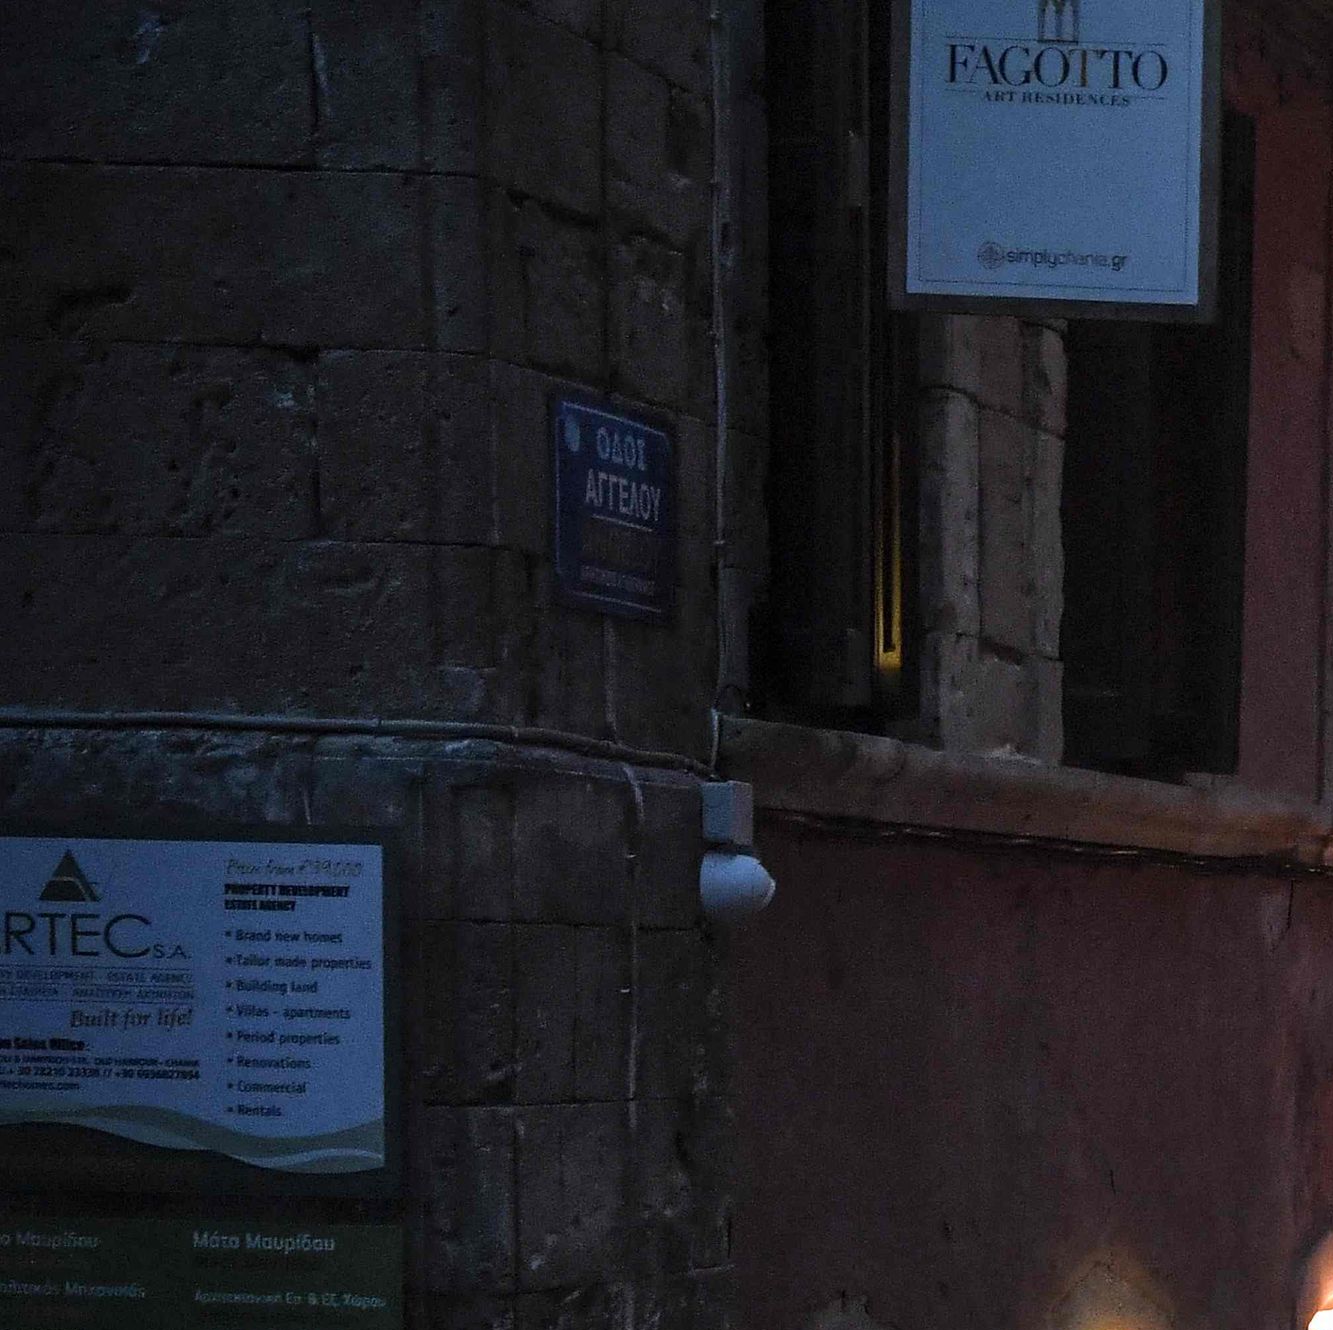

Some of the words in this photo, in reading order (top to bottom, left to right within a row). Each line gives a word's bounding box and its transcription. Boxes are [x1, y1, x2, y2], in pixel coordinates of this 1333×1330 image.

[945, 43, 1169, 91] FAGOTTO
[982, 91, 1018, 103] ART
[1021, 91, 1131, 107] RESIDENCES
[596, 426, 646, 471] ΟΔΟΣ
[585, 467, 661, 521] ΑΓΓΕΛΟΥ
[224, 883, 276, 896] PROPERTY
[279, 884, 351, 898] DEVELOPMENT
[224, 899, 257, 911] ESTATE
[259, 899, 296, 912] AGENCY
[0, 911, 152, 958] RTEC
[235, 929, 271, 942] Brand
[274, 931, 300, 942] new
[303, 930, 343, 943] homes
[236, 954, 270, 967] Tailor
[274, 956, 307, 968] made
[311, 955, 372, 971] properties
[236, 979, 288, 996] Building
[291, 980, 318, 994] land
[70, 1009, 117, 1028] Built
[122, 1008, 151, 1031] for
[157, 1008, 193, 1032] life!
[236, 1003, 270, 1018] Villas
[282, 1006, 352, 1021] apartments
[237, 1030, 276, 1043] Period
[279, 1031, 341, 1046] properties
[237, 1055, 312, 1069] Renovations
[237, 1080, 307, 1094] Commercial
[237, 1104, 282, 1117] Rentals
[244, 1231, 336, 1255] Μαυρίδου
